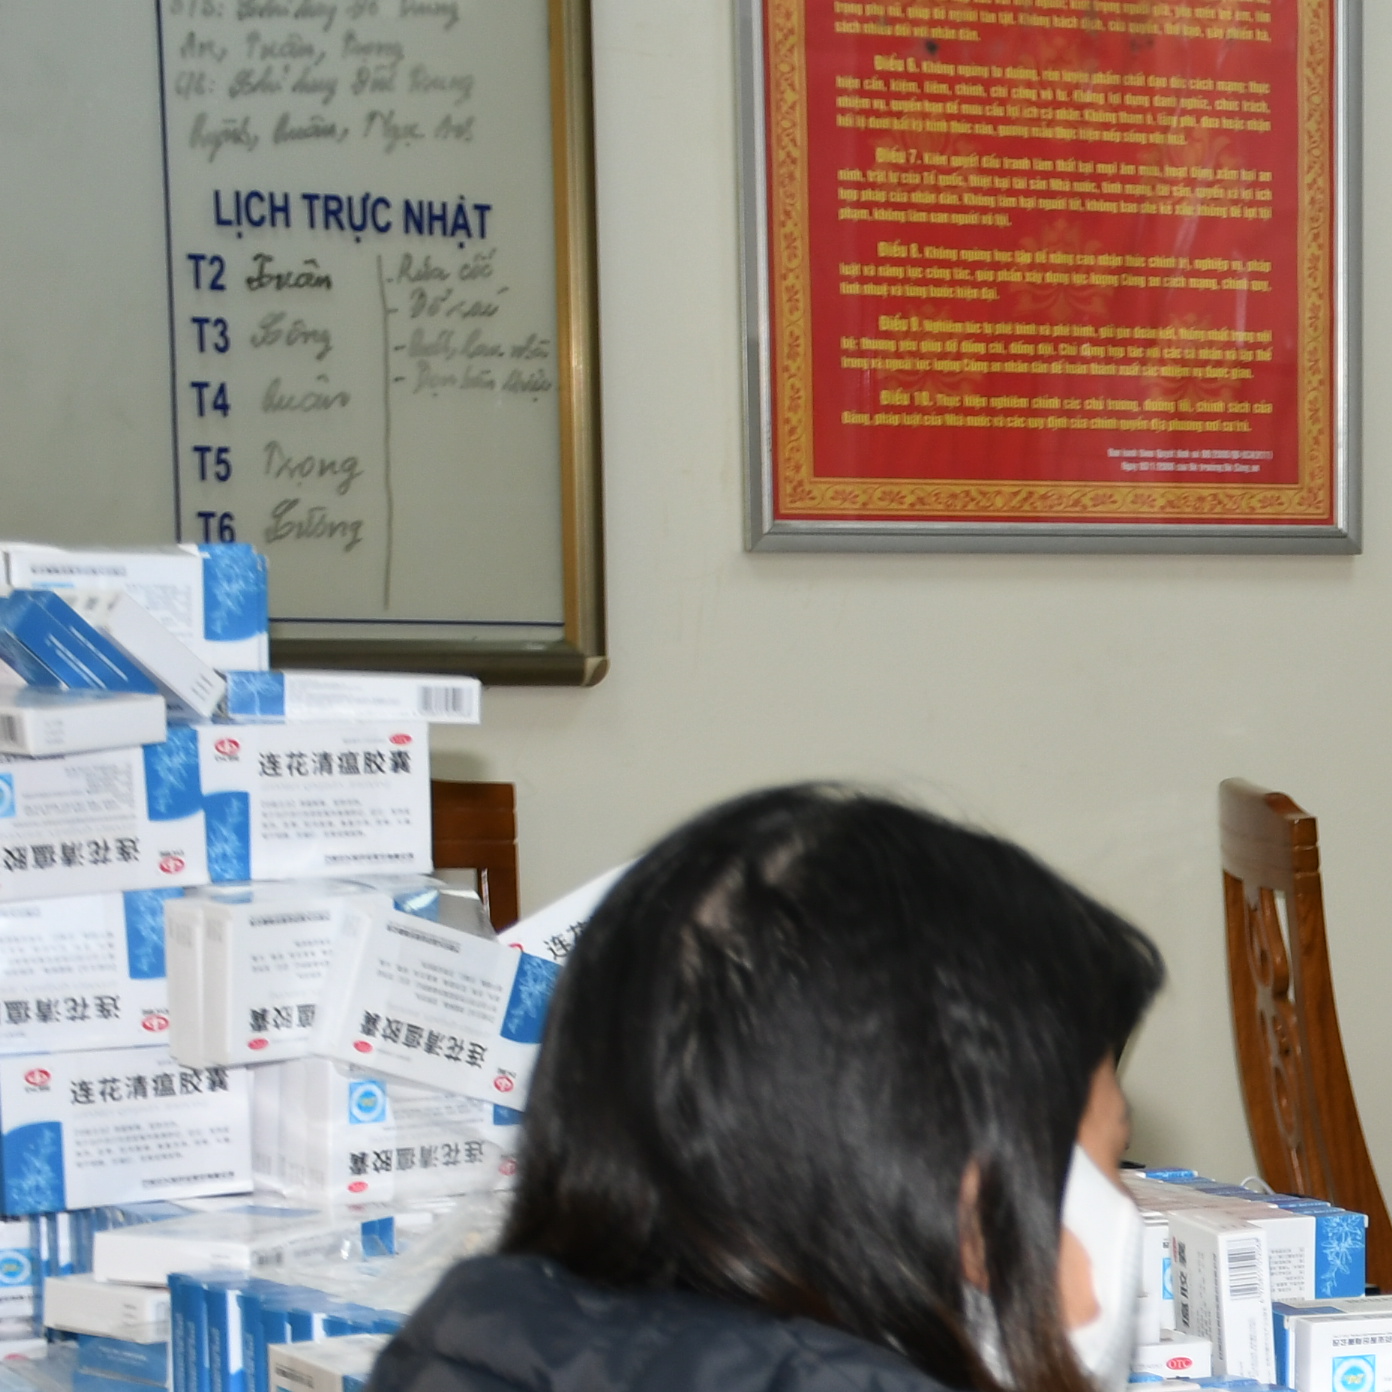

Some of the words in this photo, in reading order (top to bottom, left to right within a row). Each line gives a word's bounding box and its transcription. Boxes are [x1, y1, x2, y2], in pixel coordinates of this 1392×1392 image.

[213, 189, 291, 240] LỊCH
[301, 191, 392, 244] TRỰC
[403, 196, 493, 250] NHẬT
[187, 253, 226, 291] T2
[190, 316, 230, 353] T3
[190, 381, 230, 417] T4
[193, 446, 232, 482] T5
[197, 511, 236, 544] T6
[257, 748, 413, 778] 连花清瘟胶囊
[1167, 1358, 1191, 1369] OTC
